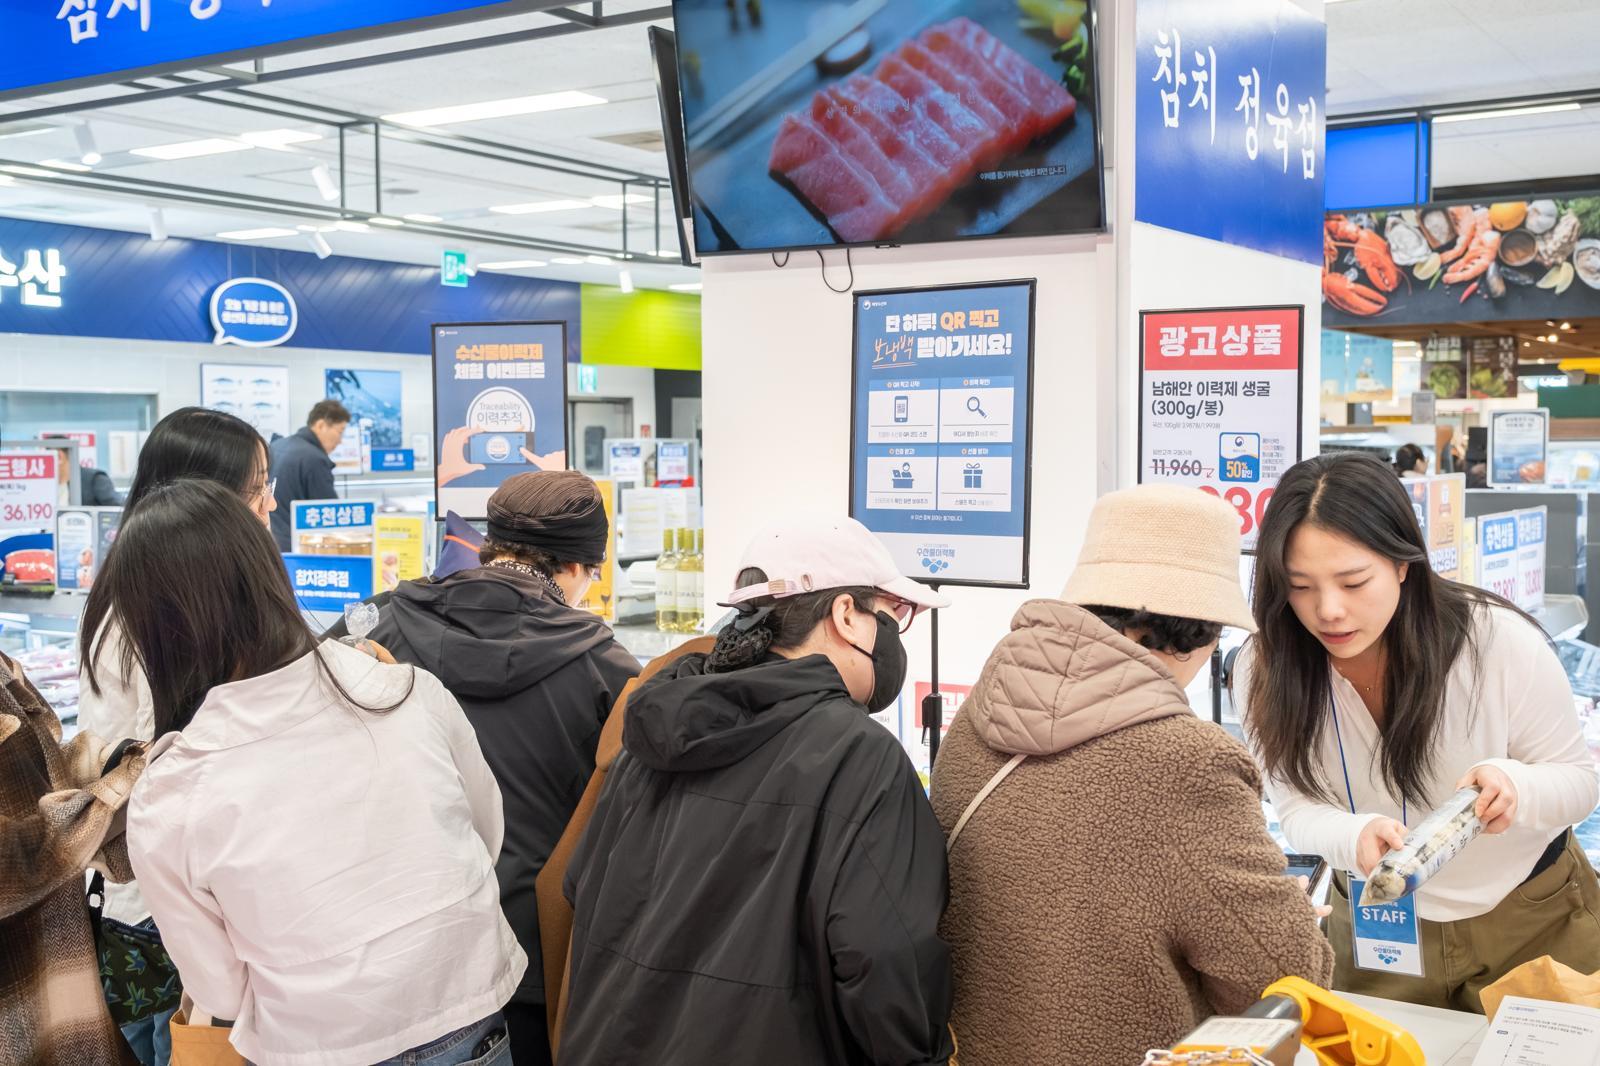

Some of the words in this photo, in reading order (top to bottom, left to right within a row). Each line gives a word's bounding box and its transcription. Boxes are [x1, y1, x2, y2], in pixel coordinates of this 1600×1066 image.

[1152, 28, 1216, 145] 참치
[1235, 67, 1316, 179] 정육점
[1037, 168, 1048, 176] 화면
[1048, 166, 1065, 175] 입니다
[886, 315, 900, 332] 단
[903, 313, 936, 331] 하루!
[940, 311, 966, 332] QR
[969, 309, 999, 328] 찍고
[873, 334, 914, 362] 보냉백
[917, 333, 1012, 358] 받아가세요!
[1160, 324, 1281, 357] 광고상품
[456, 344, 543, 360] 수산물이력제
[454, 363, 483, 380] 체험
[487, 362, 544, 379] 이벤트존
[1152, 381, 1192, 397] 남해안
[1197, 381, 1238, 397] 이력제
[1242, 381, 1270, 397] 생굴
[480, 402, 520, 413] Traceability
[1152, 400, 1224, 419] (300g/봉)
[477, 412, 522, 425] 이력추적
[1152, 459, 1202, 477] 11,960
[1226, 460, 1248, 478] 50%
[1242, 470, 1252, 478] 할인
[4, 504, 52, 521] 36,190
[306, 506, 365, 527] 추천상품
[1486, 522, 1515, 551] 추천상품
[295, 569, 349, 588] 참치정육점
[1362, 908, 1407, 924] STAFF
